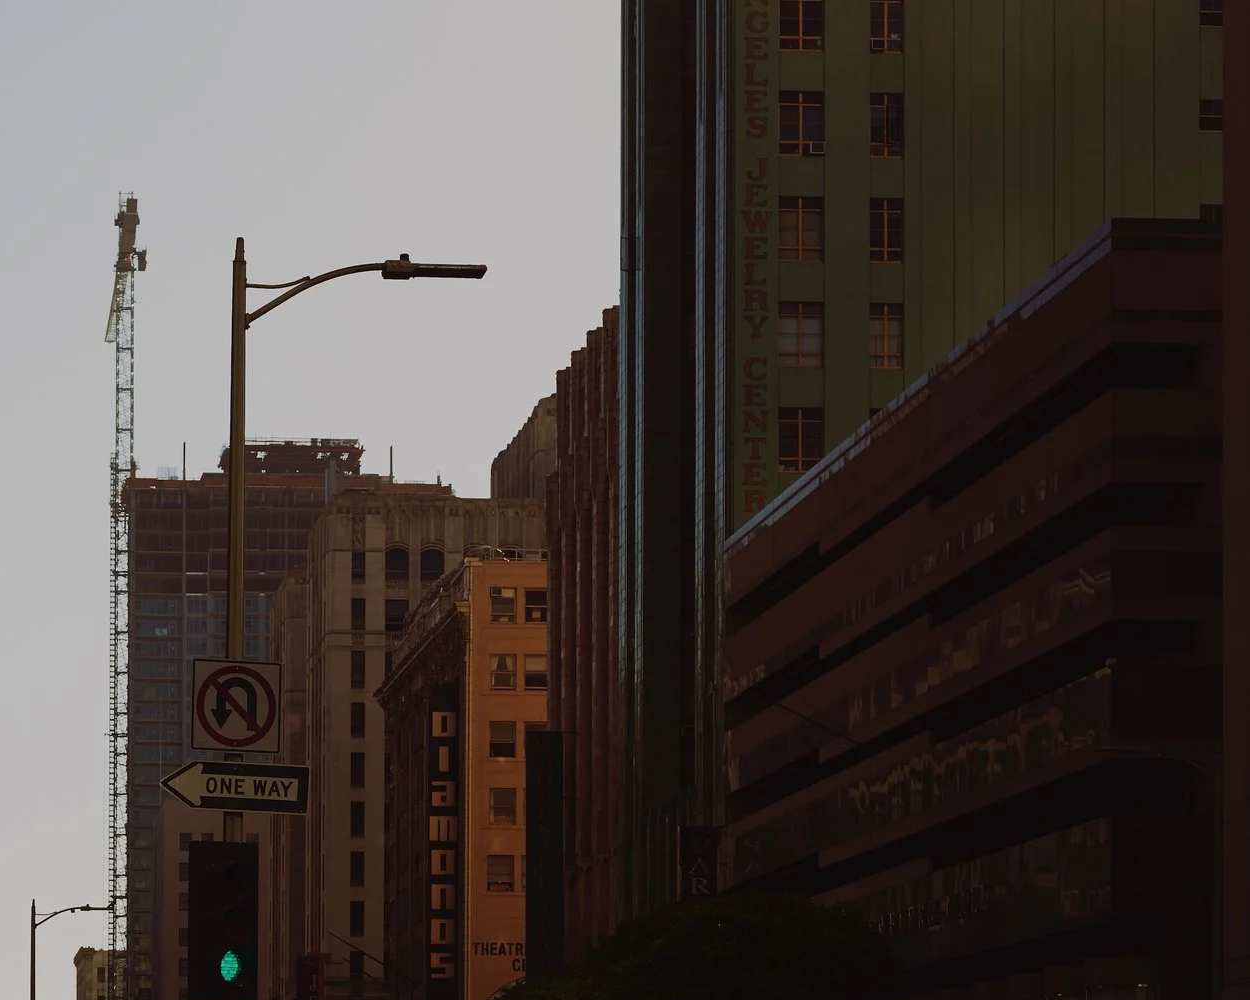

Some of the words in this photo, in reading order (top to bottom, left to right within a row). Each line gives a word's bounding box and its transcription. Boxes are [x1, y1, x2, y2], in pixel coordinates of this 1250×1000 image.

[743, 0, 769, 139] GELES
[741, 158, 773, 340] JEWELRY
[742, 357, 768, 514] CENTER
[206, 776, 245, 796] ONE
[253, 779, 294, 798] WAY
[473, 942, 526, 956] THEATR
